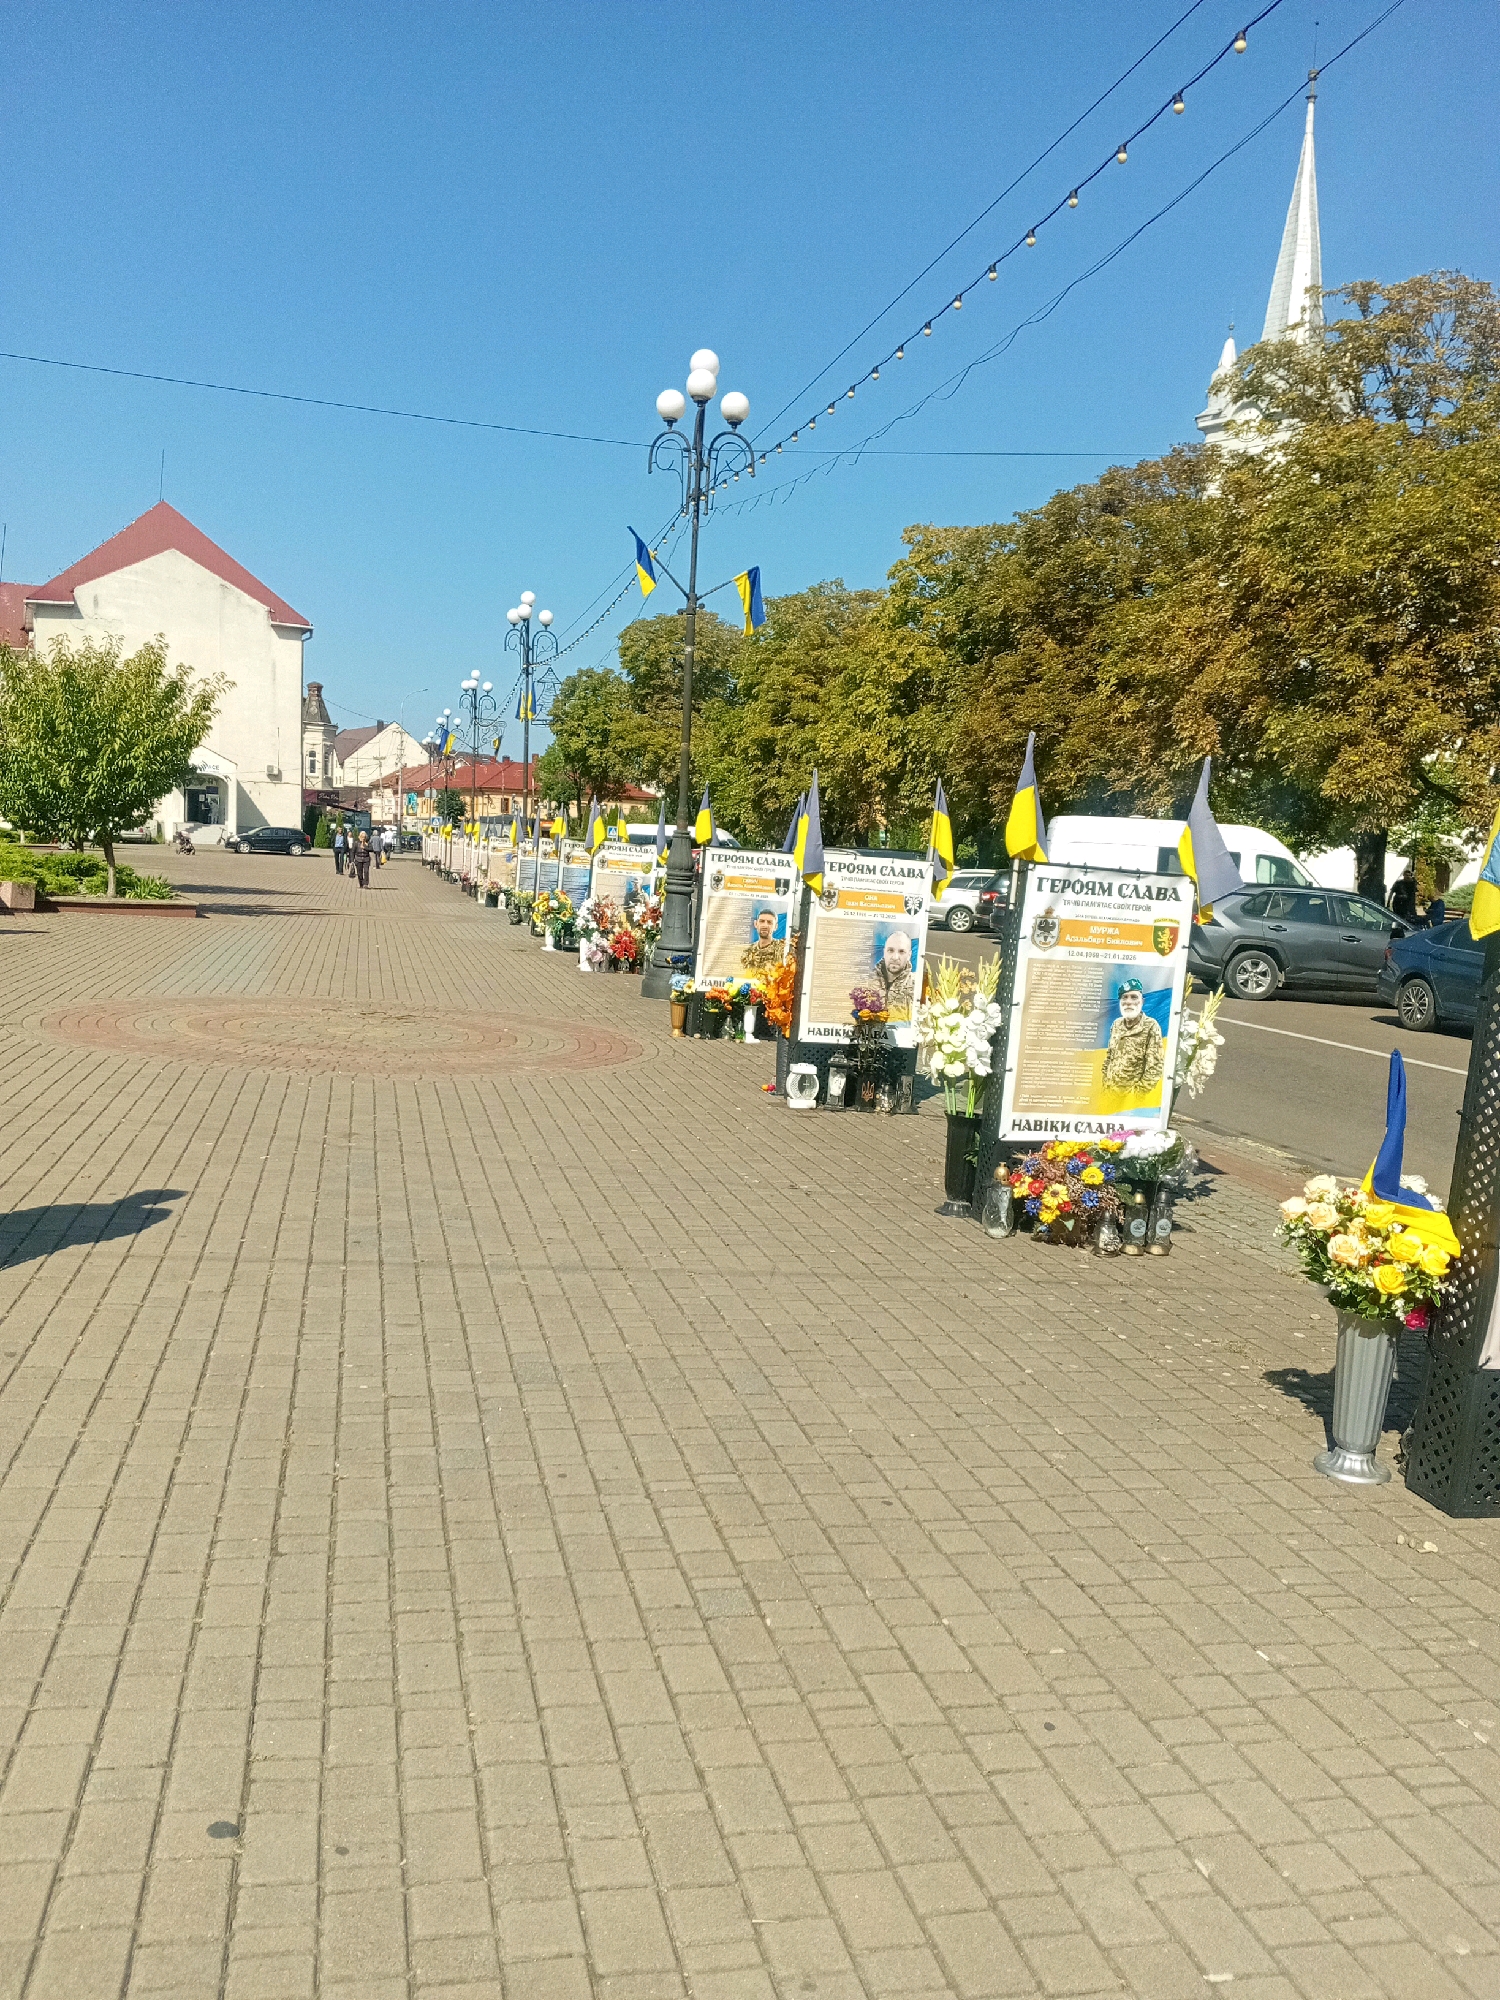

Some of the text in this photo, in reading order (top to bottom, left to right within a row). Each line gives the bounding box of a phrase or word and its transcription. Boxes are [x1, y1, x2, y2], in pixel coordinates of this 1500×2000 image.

[711, 853, 754, 865] ГЕРОЯМ
[756, 857, 792, 868] СЛАВА
[880, 865, 925, 880] СЛАВА
[1037, 876, 1183, 902] ГЕРОЯМ СЛАВА
[1089, 925, 1120, 936] МУРЖА
[1011, 1117, 1125, 1135] НАВІКИ СЛАВА
